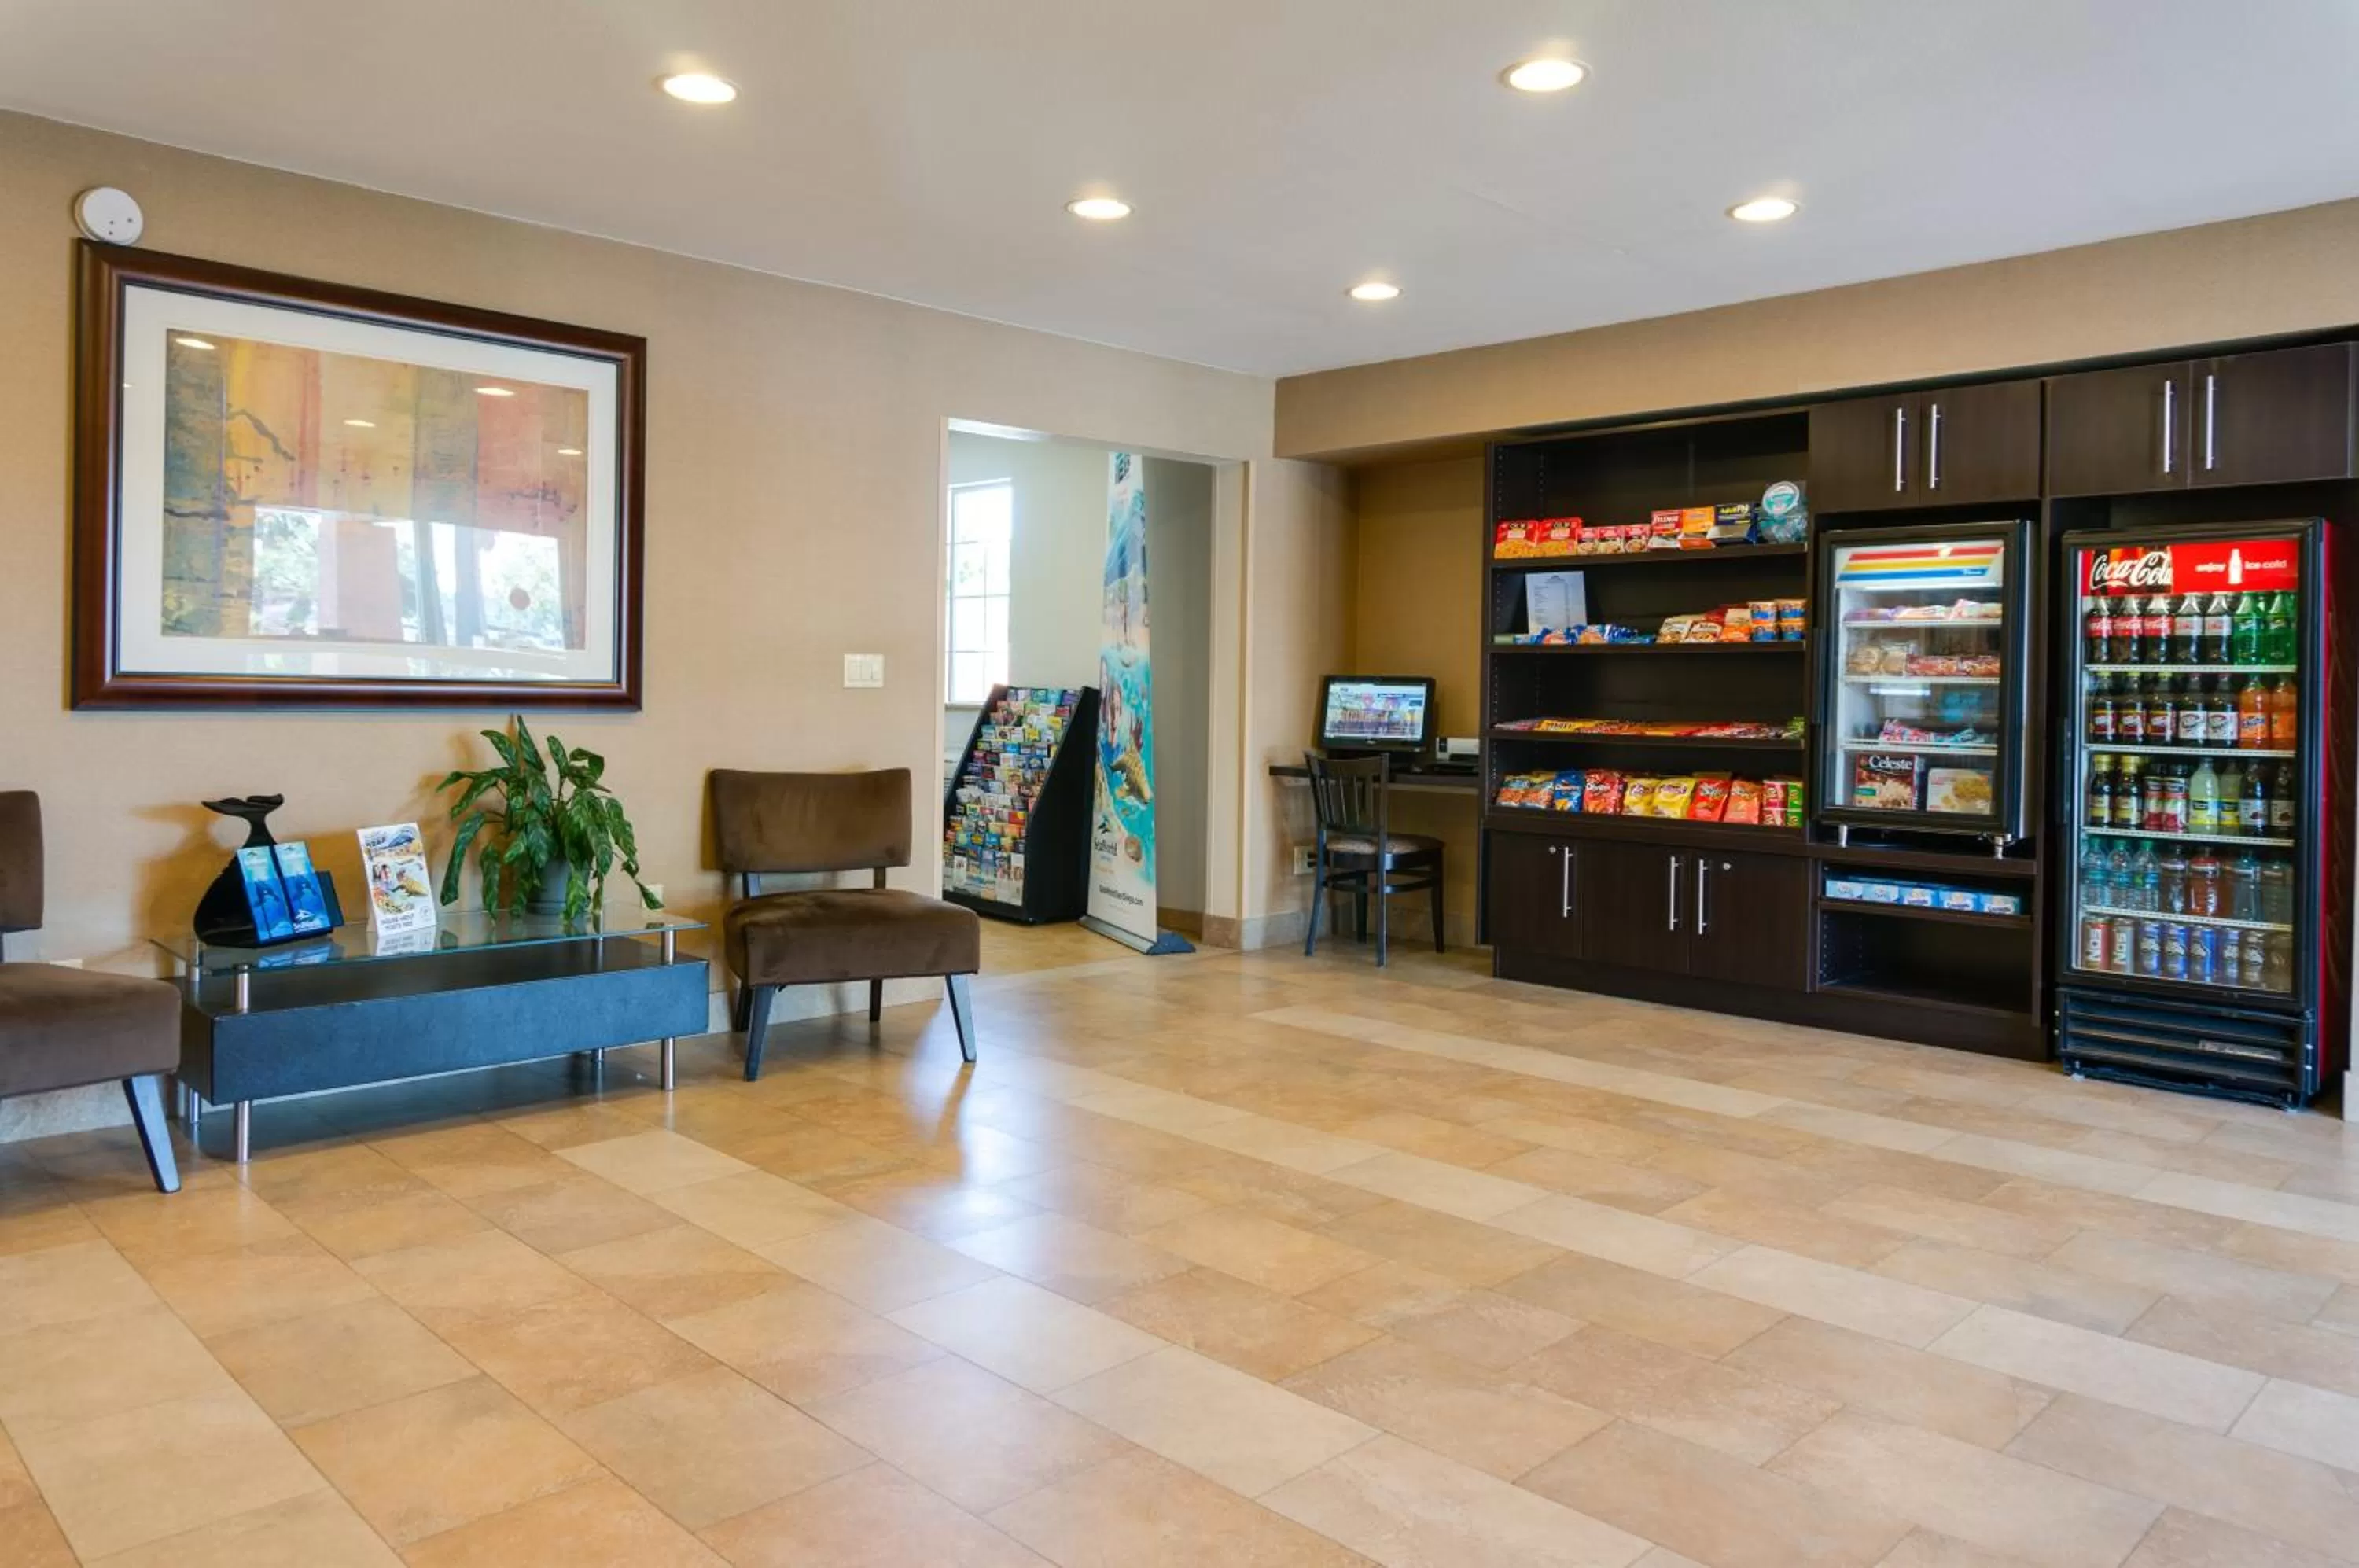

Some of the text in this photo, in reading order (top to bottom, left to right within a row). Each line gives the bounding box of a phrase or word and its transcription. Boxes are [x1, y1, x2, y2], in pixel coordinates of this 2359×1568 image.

[2089, 551, 2173, 590] Coca-Cola
[2195, 563, 2226, 573] enjoy
[2262, 560, 2287, 569] cold
[1868, 755, 1913, 771] Celeste
